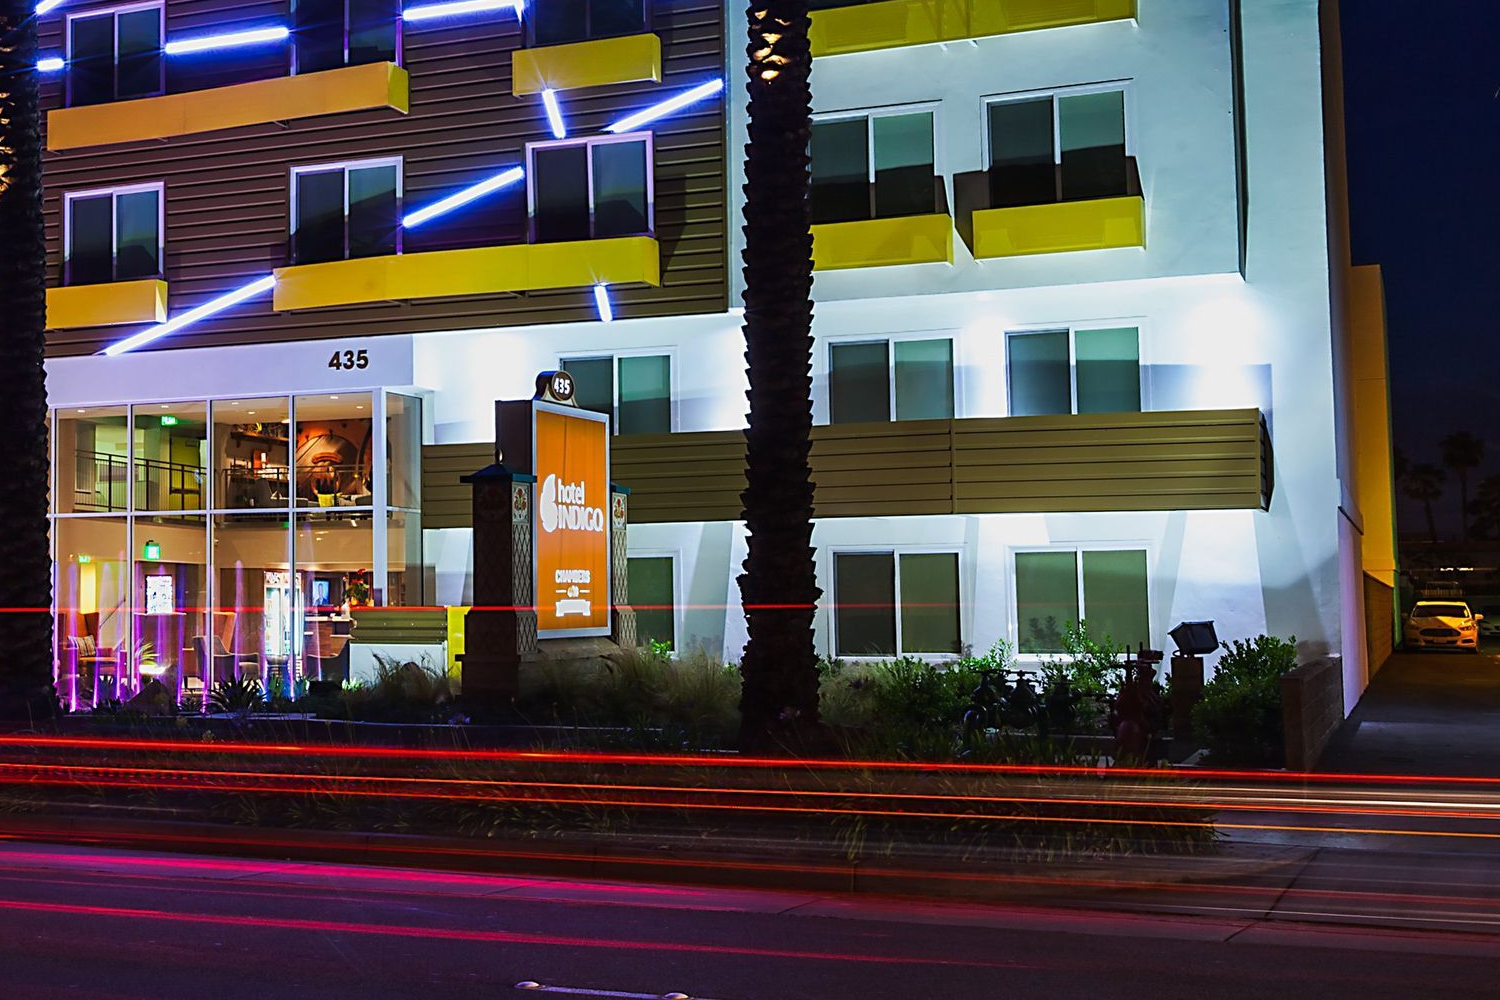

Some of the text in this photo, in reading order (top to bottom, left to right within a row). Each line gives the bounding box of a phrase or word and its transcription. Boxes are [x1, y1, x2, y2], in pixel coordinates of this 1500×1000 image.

[328, 349, 369, 371] 435
[553, 377, 571, 395] 435
[557, 478, 585, 505] hotel
[557, 504, 604, 532] INDIGO
